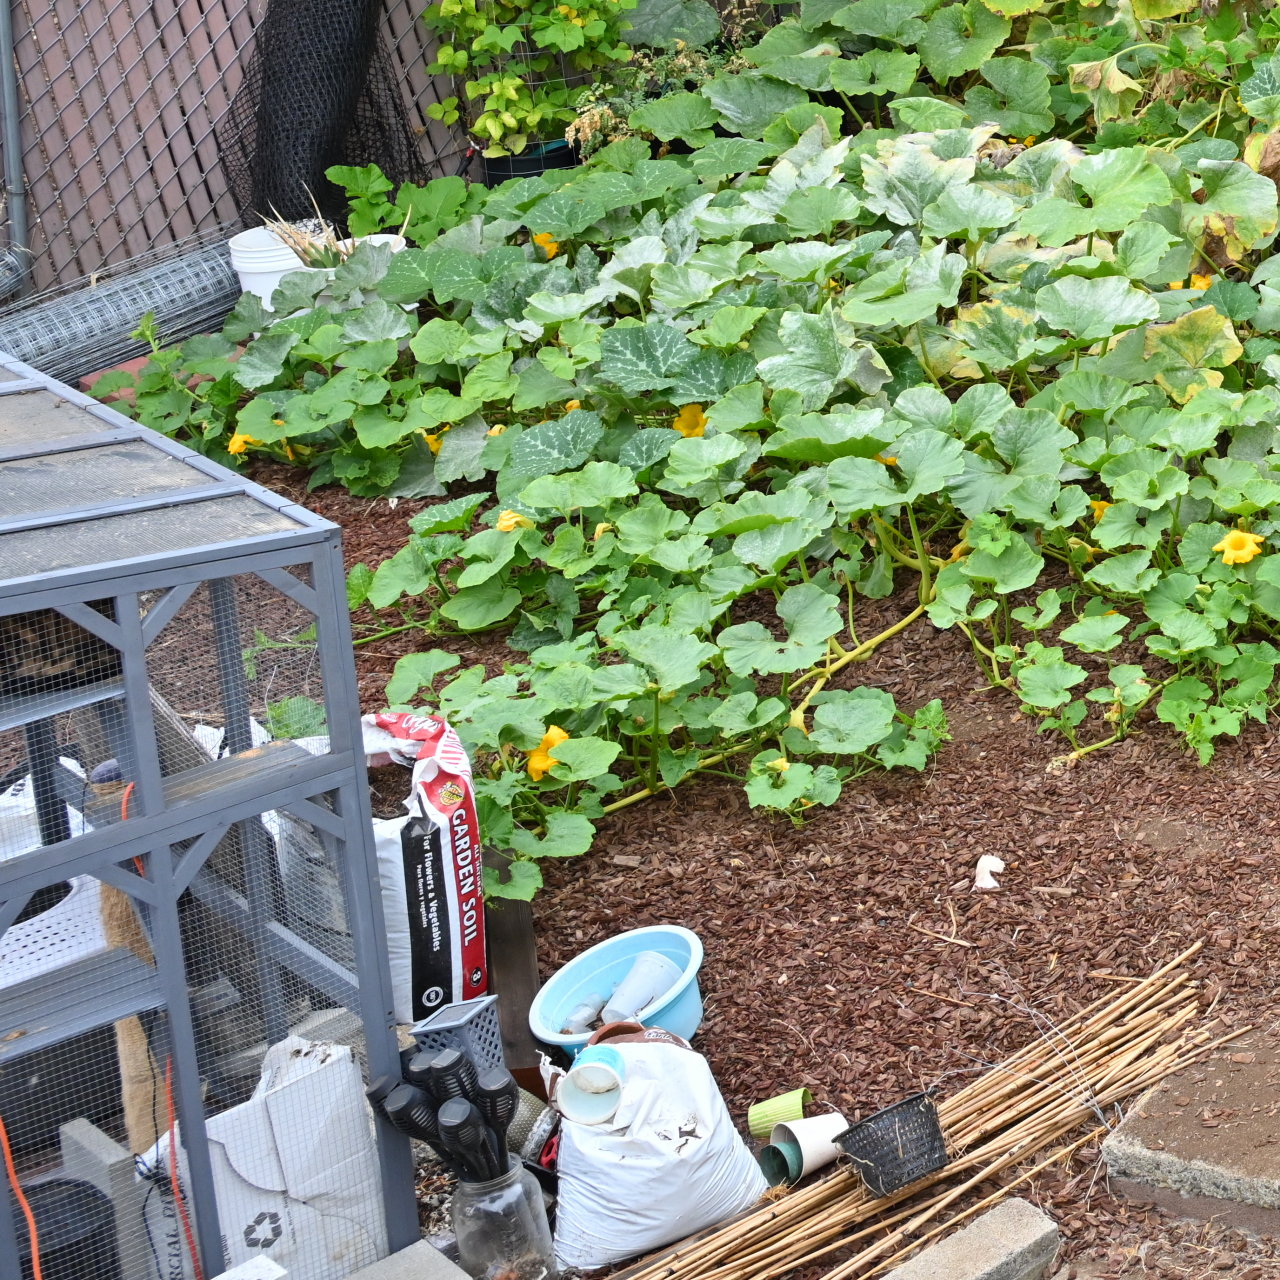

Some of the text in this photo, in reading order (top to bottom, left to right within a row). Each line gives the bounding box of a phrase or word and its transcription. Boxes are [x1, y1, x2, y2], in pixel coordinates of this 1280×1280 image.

[423, 834, 431, 850] For
[452, 808, 475, 895] GARDEN
[424, 852, 434, 890] Flowers
[420, 901, 428, 928] vegetales
[428, 899, 441, 952] Vegetables
[462, 897, 478, 947] SOIL
